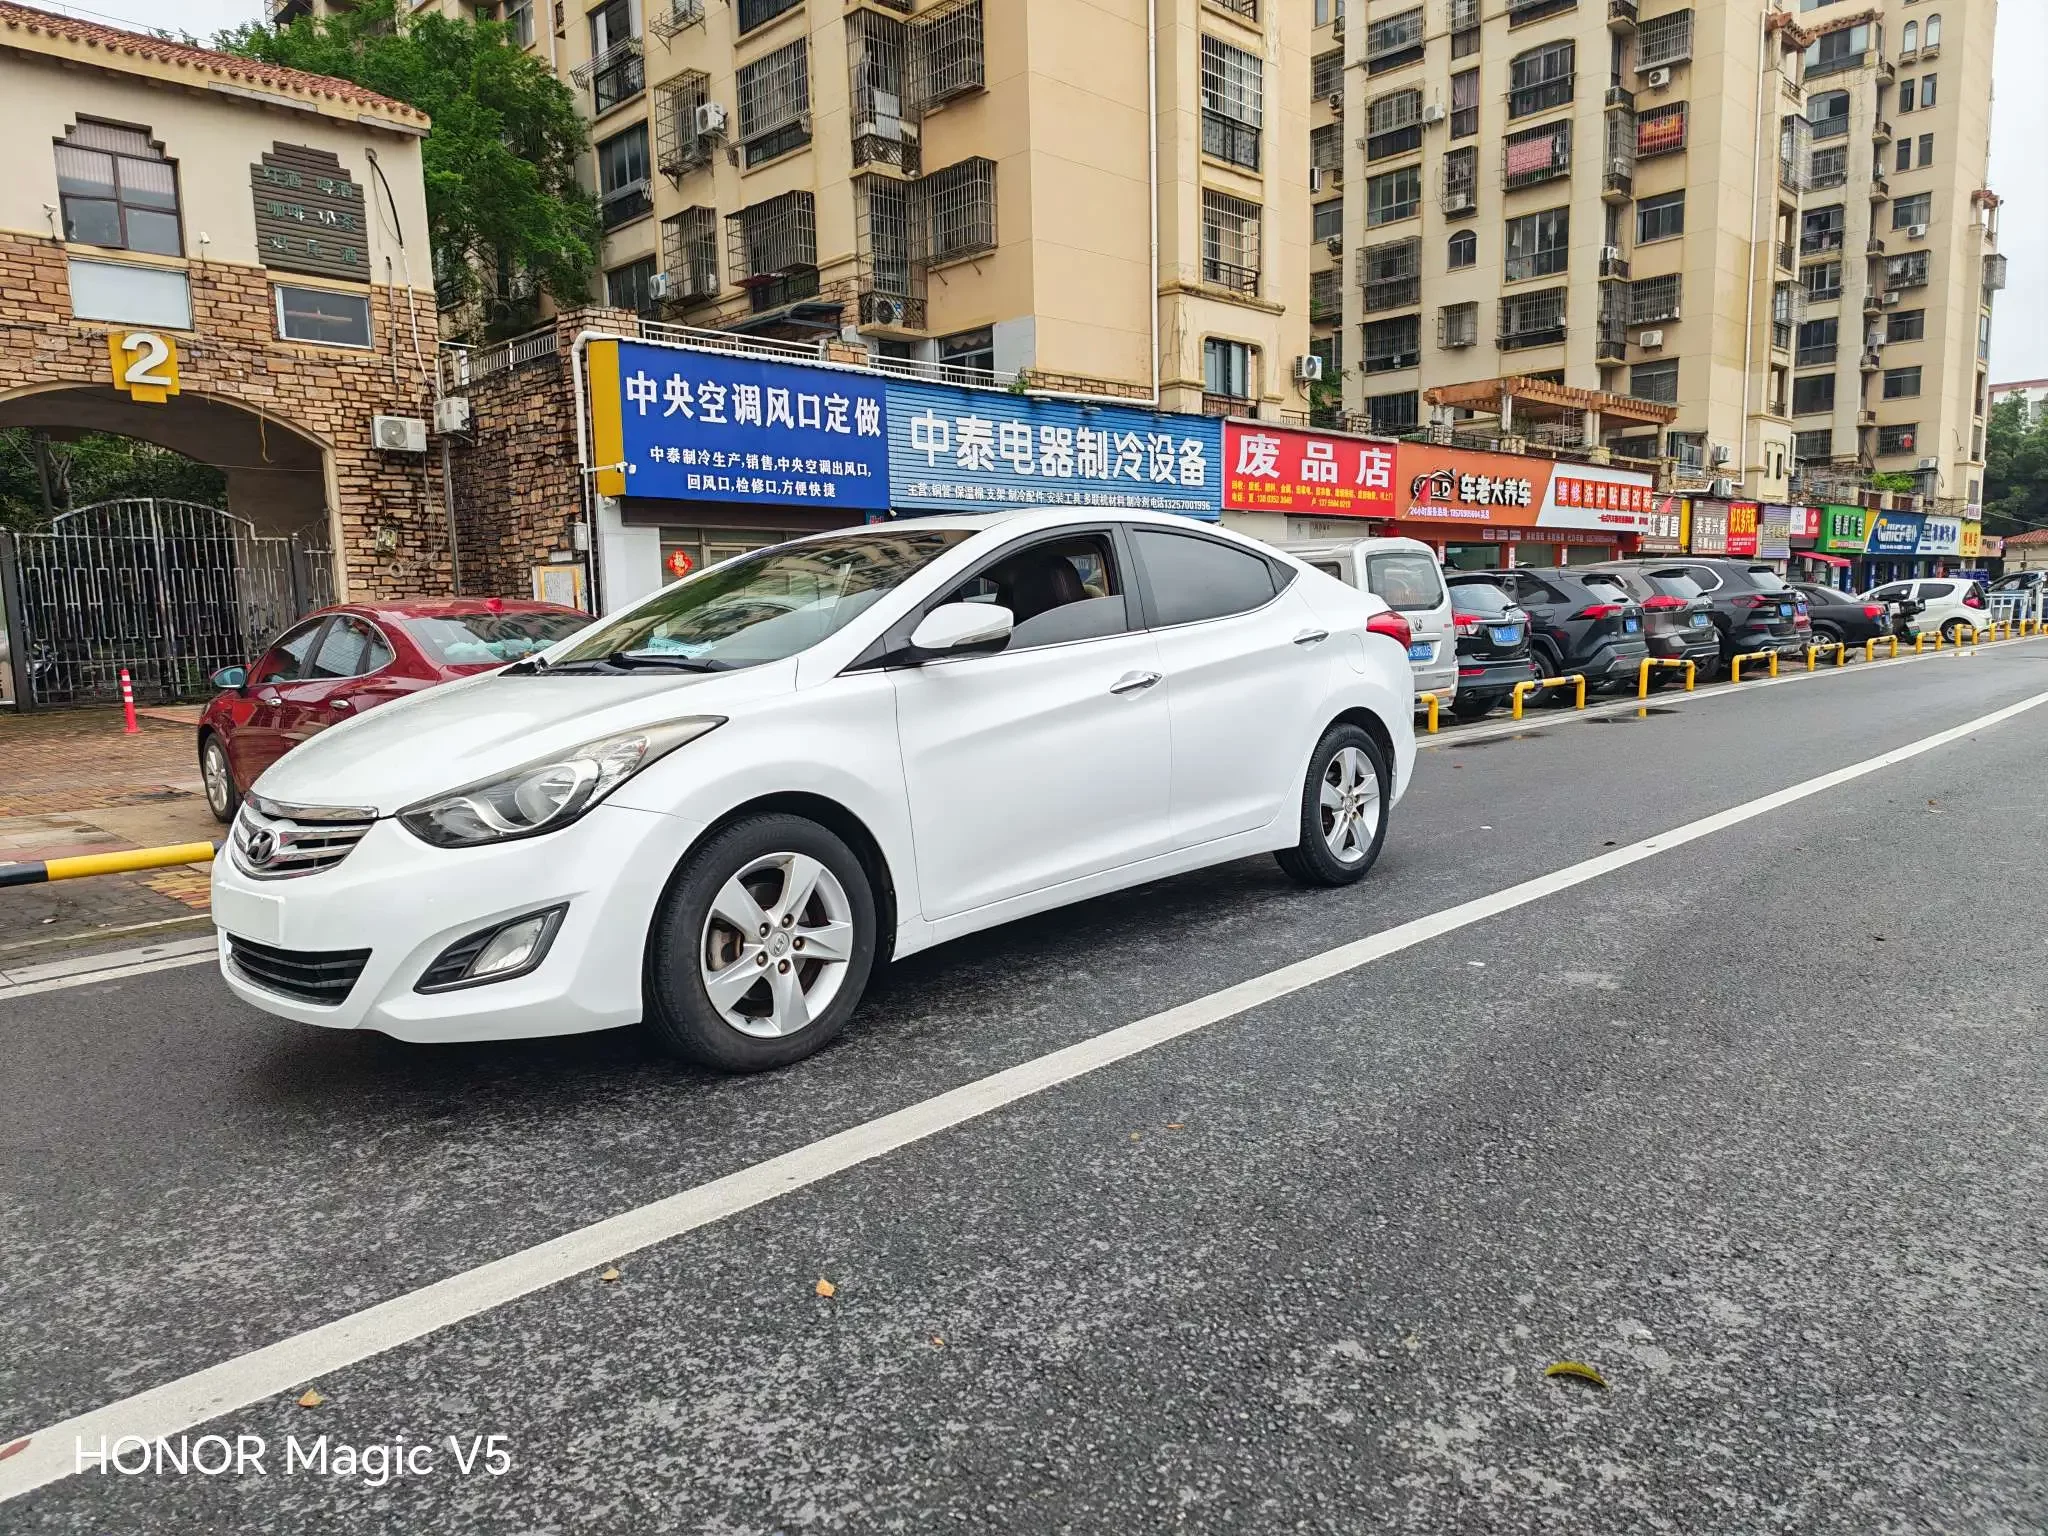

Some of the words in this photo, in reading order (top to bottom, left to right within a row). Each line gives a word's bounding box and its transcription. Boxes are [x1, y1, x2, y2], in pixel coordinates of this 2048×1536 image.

[264, 166, 302, 188] 红酒
[316, 176, 353, 198] 啤酒
[267, 200, 304, 221] 咖啡
[122, 333, 171, 385] 2
[626, 370, 881, 438] 中央空调风口定做
[910, 408, 1207, 487] 中泰电器制冷设备
[1235, 433, 1392, 488] 废品店
[1460, 473, 1531, 507] 车老大养车
